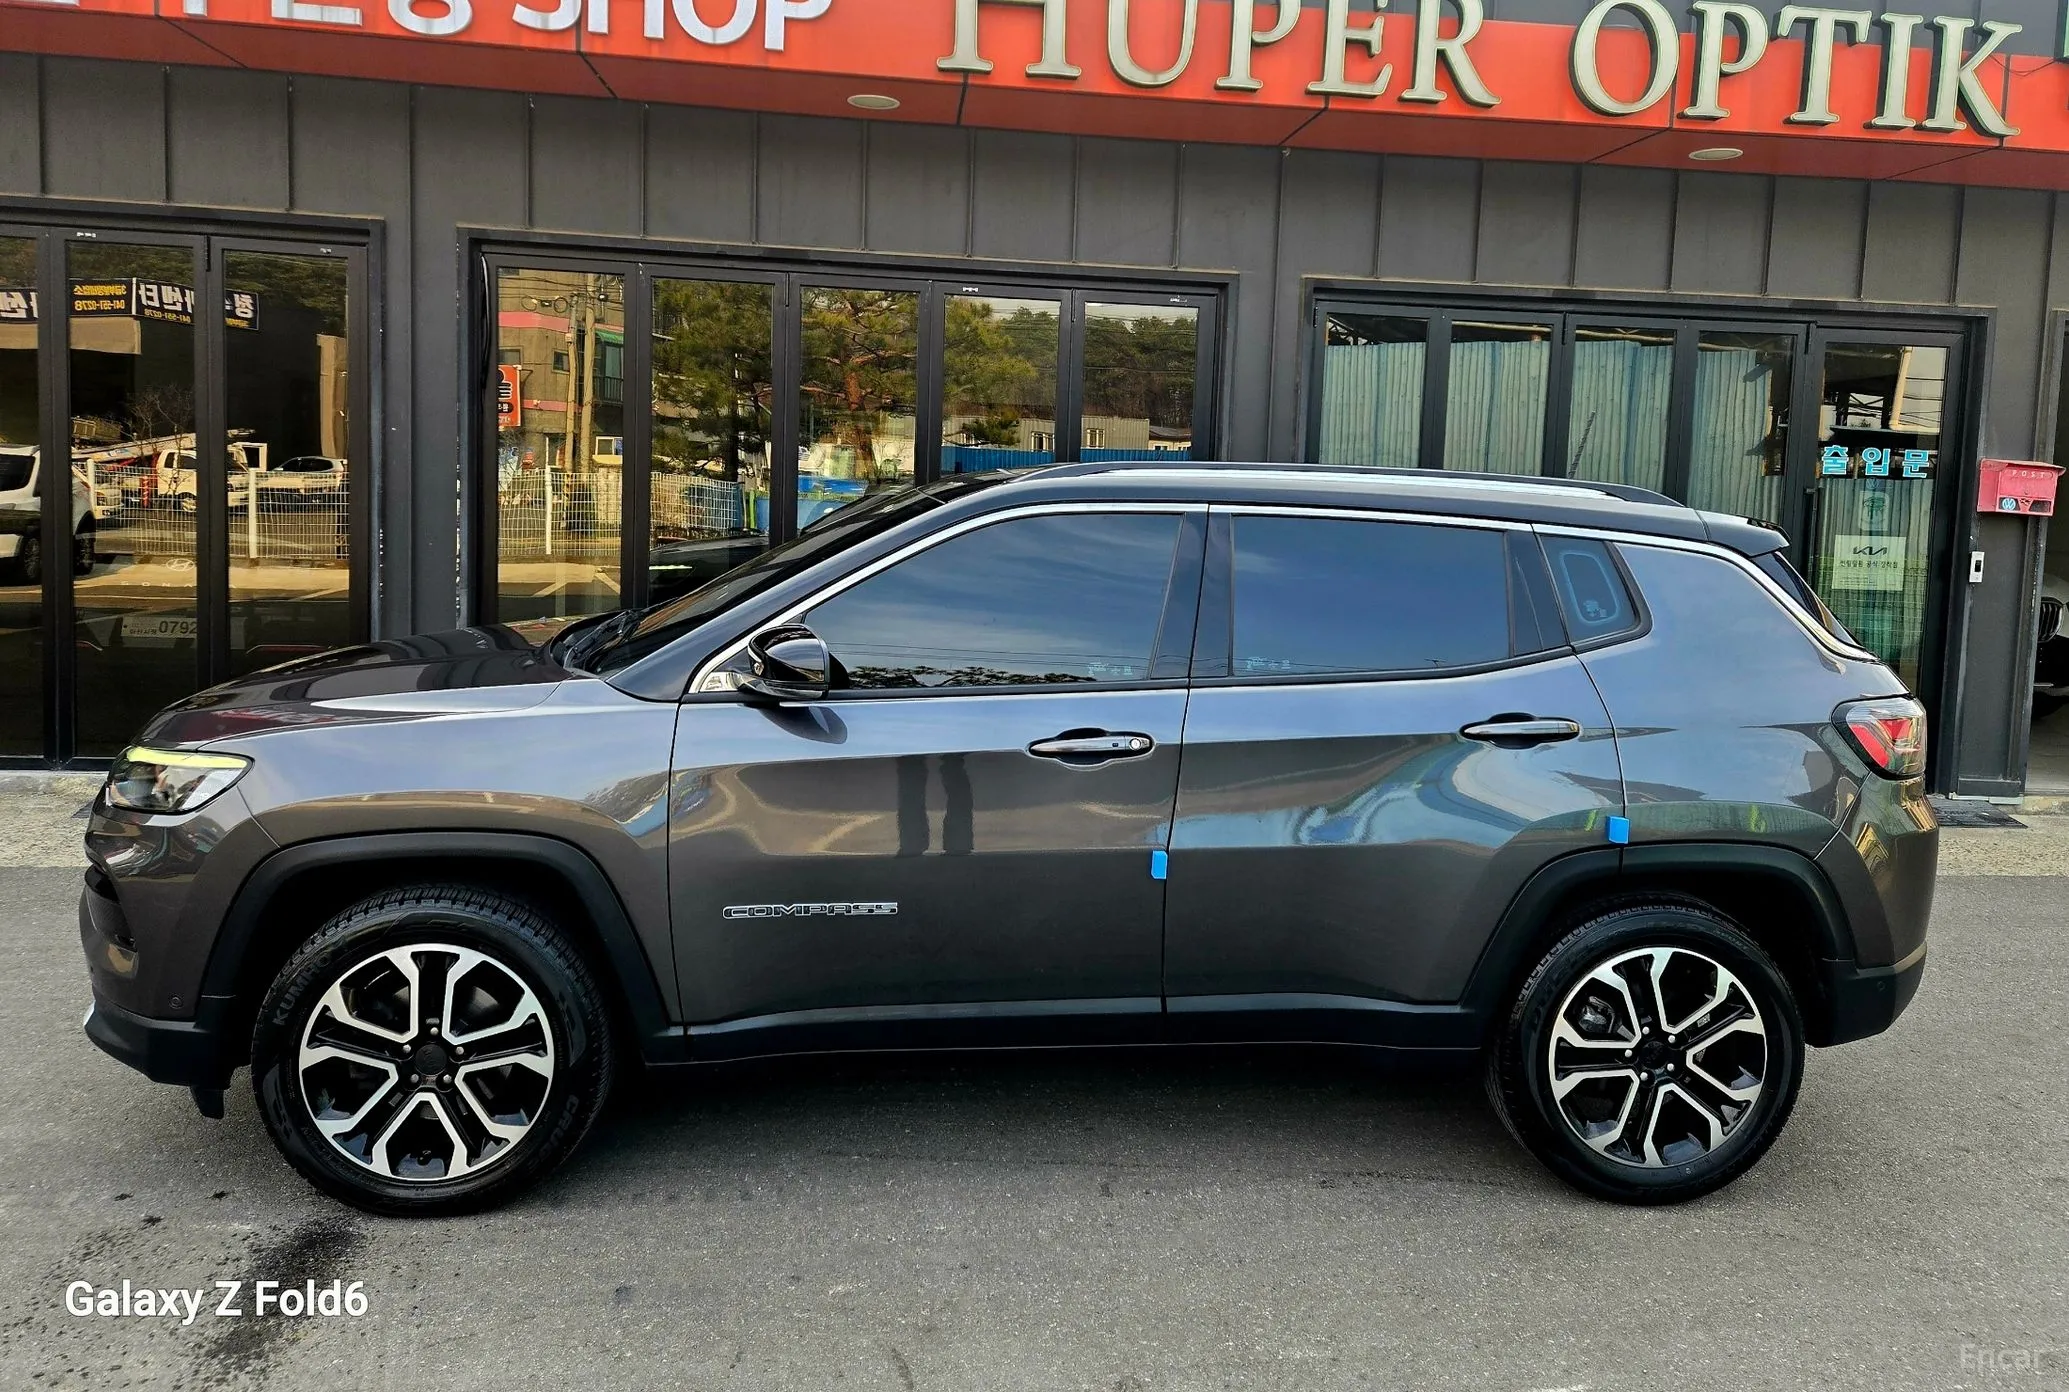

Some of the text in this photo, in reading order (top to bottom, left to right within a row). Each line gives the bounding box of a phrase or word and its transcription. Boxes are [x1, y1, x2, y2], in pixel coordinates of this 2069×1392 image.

[936, 0, 2024, 137] HUPER OPTIK
[1821, 446, 1929, 478] 출입문
[2011, 469, 2047, 479] POST
[722, 901, 899, 919] COMPASS
